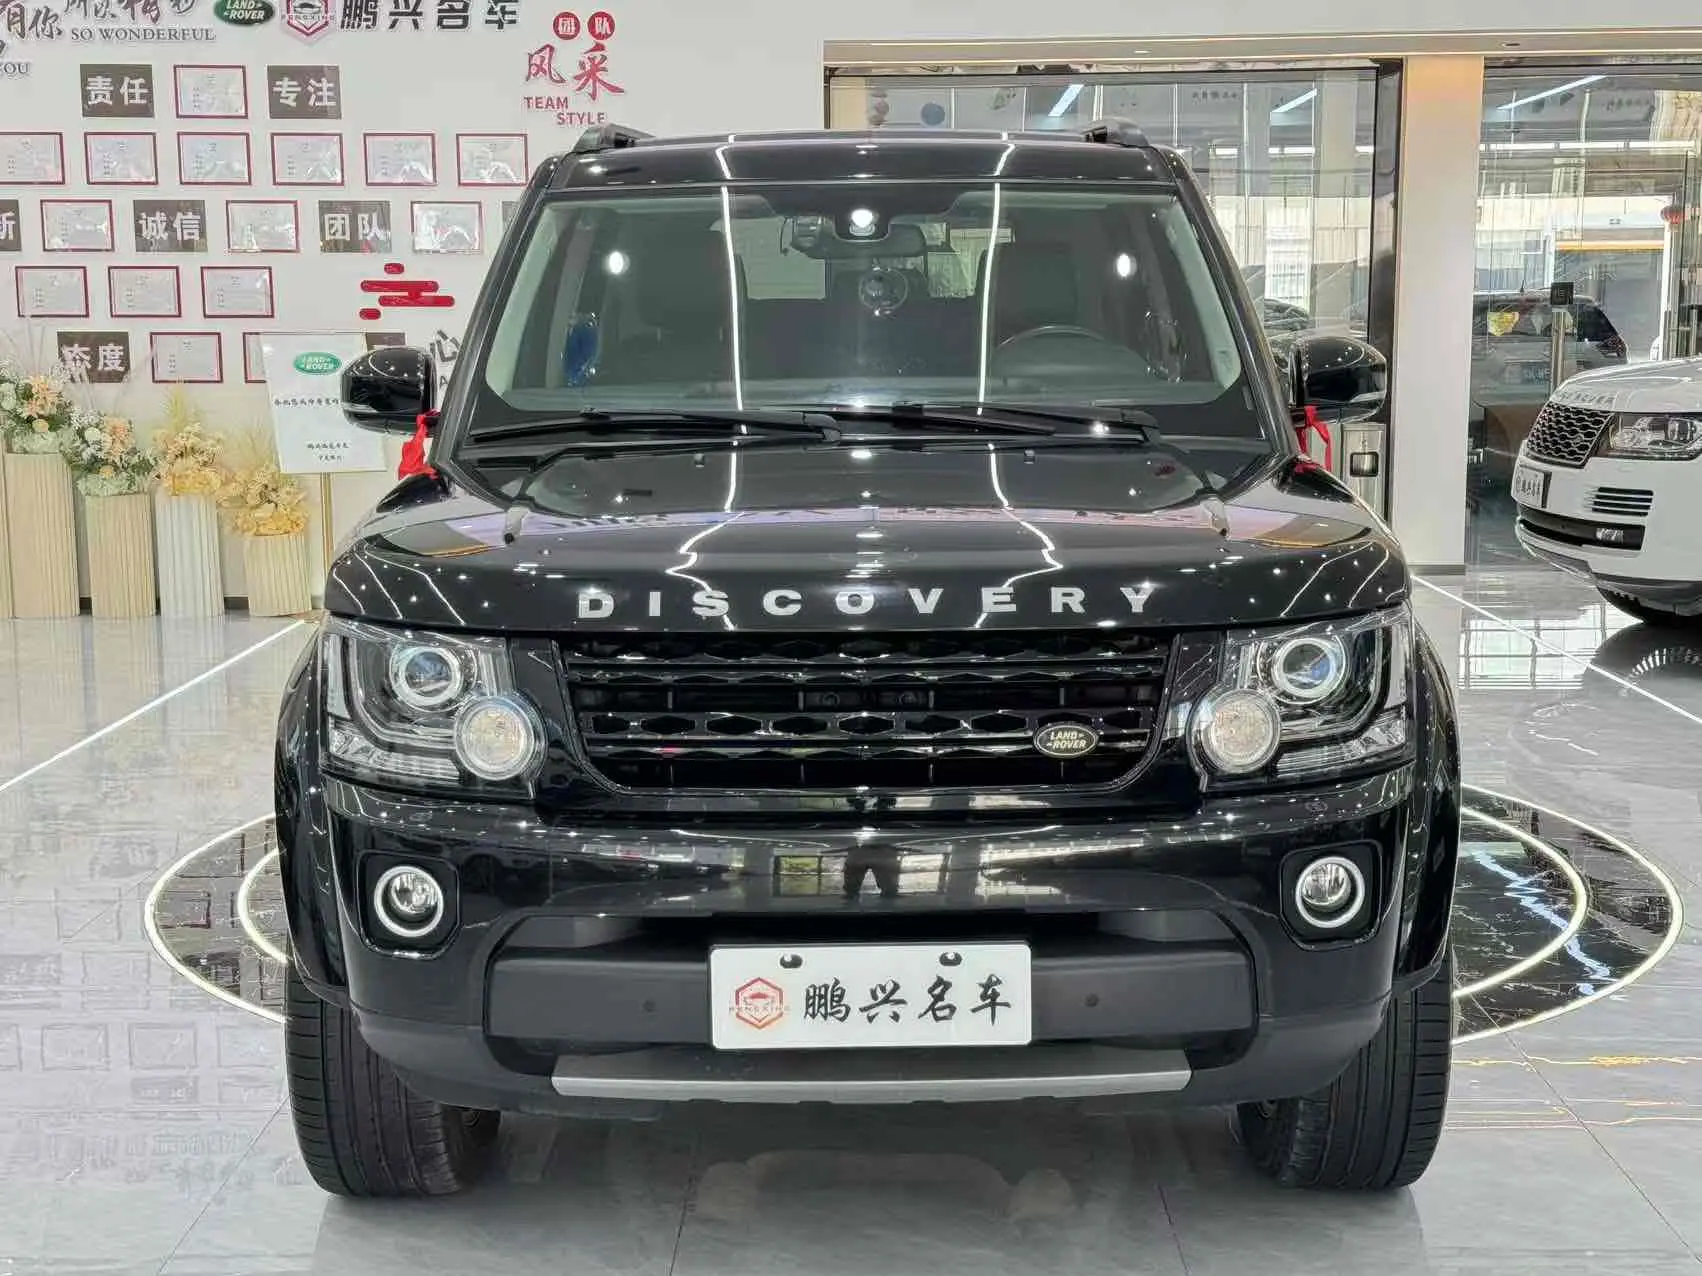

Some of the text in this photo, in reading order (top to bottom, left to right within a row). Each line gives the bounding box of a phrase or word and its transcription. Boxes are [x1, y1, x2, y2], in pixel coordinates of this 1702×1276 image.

[229, 10, 265, 20] ROVER
[340, 0, 519, 30] 鹏兴名车
[71, 29, 216, 41] SO WONDERFUL
[0, 62, 31, 75] OU
[525, 42, 626, 101] 风采
[86, 75, 149, 106] 责任
[271, 77, 337, 108] 专注
[524, 97, 569, 110] TEAM
[557, 112, 606, 126] STYLE
[138, 211, 201, 241] 诚信
[324, 213, 387, 241] 团队
[61, 342, 127, 373] 态度
[578, 586, 1159, 619] DISCOVERY
[1050, 731, 1078, 741] LAND
[1052, 740, 1087, 750] ROVER
[803, 973, 1012, 1026] 鹏兴名车
